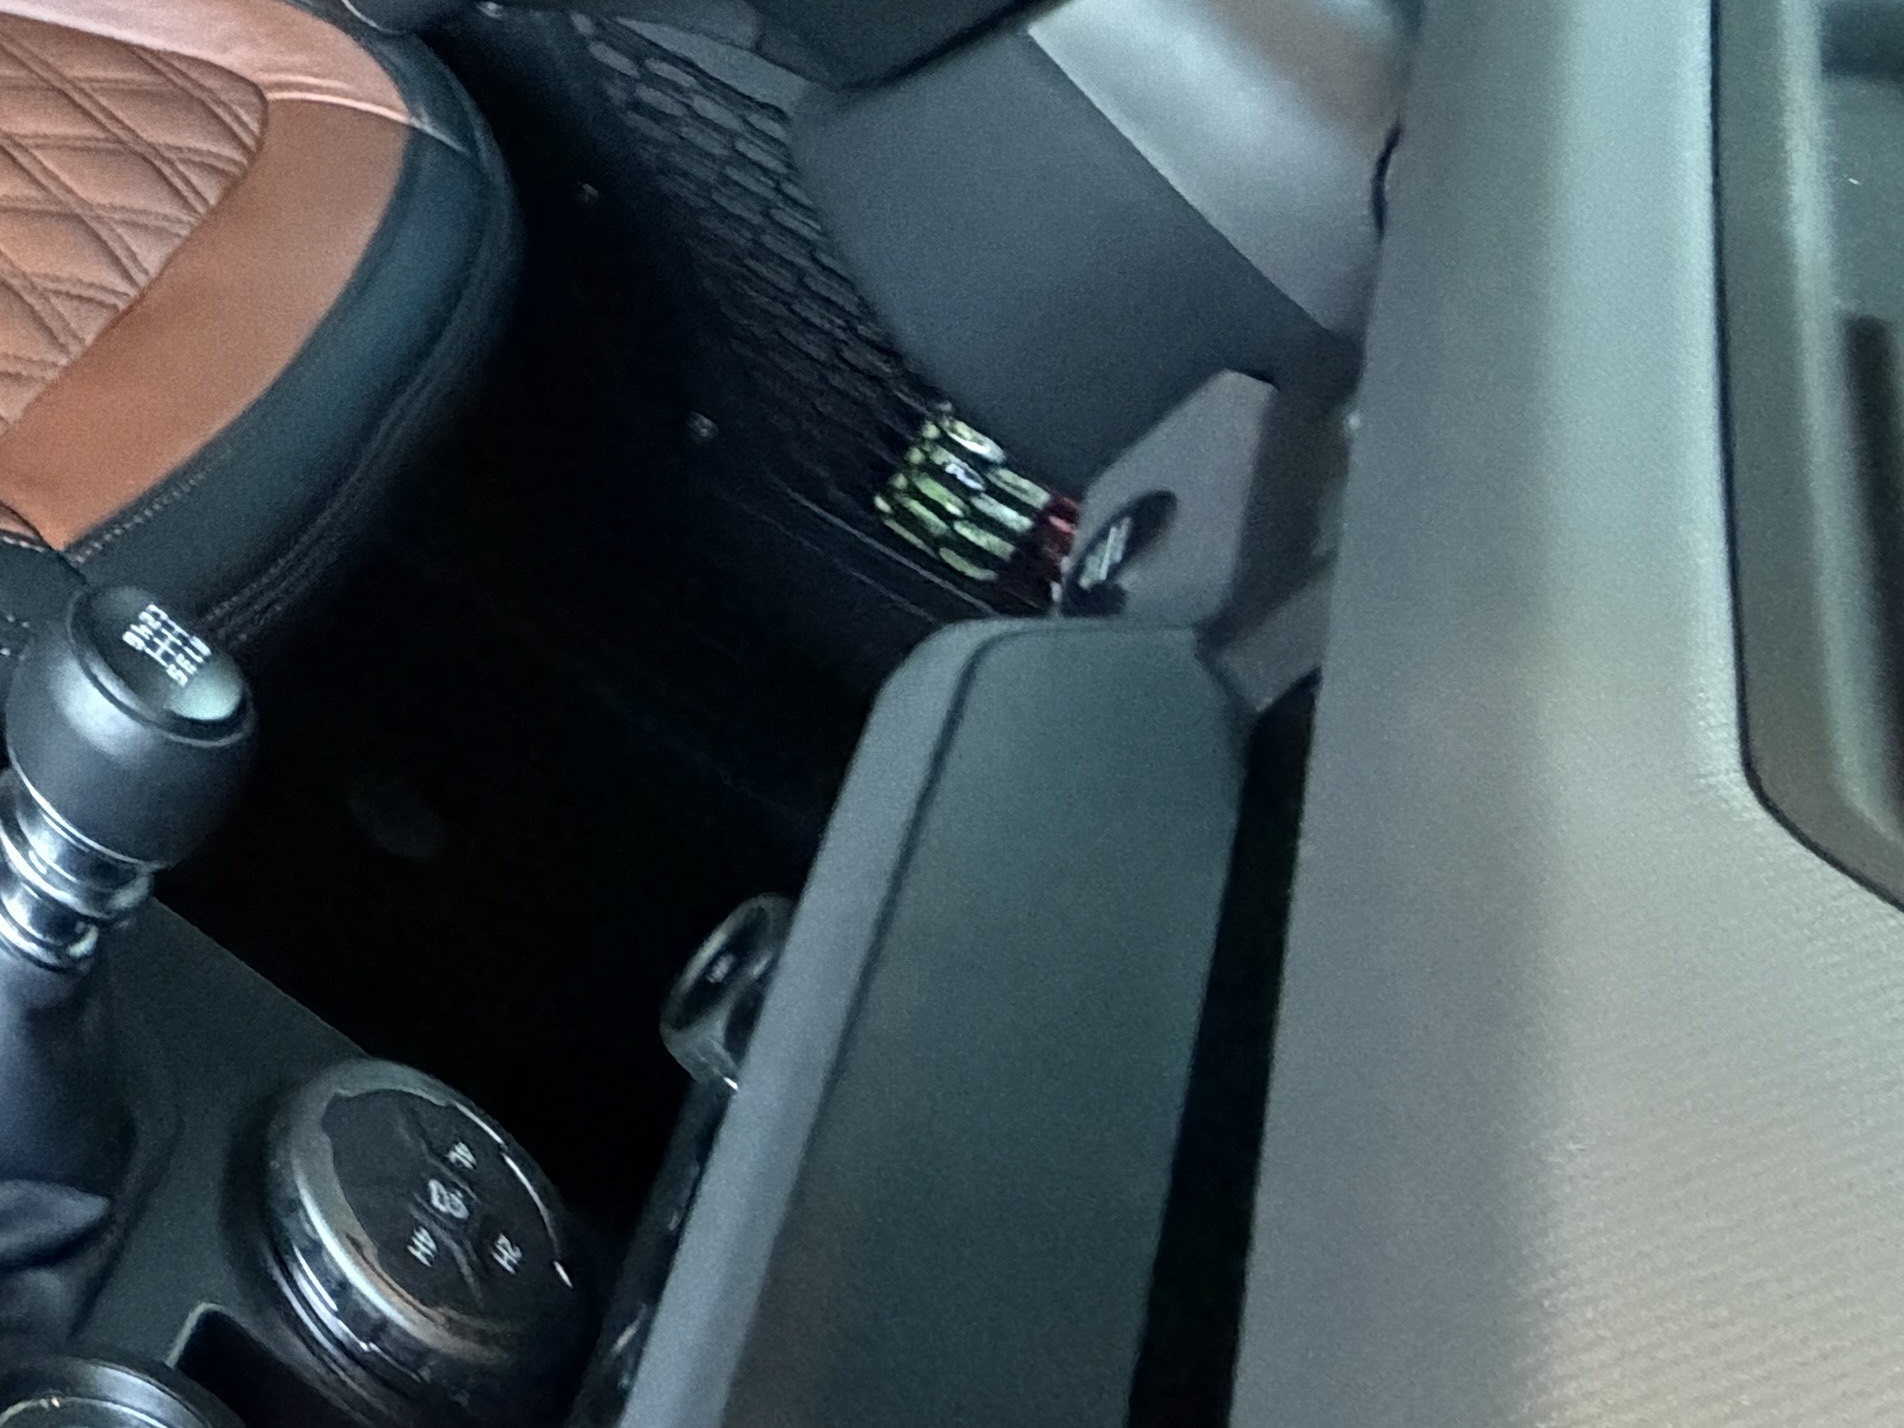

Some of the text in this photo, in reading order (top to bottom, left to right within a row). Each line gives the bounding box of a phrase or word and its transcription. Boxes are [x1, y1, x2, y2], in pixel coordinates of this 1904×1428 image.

[445, 1141, 477, 1170] 4L
[407, 1225, 438, 1267] 4H
[491, 1233, 523, 1274] 2H
